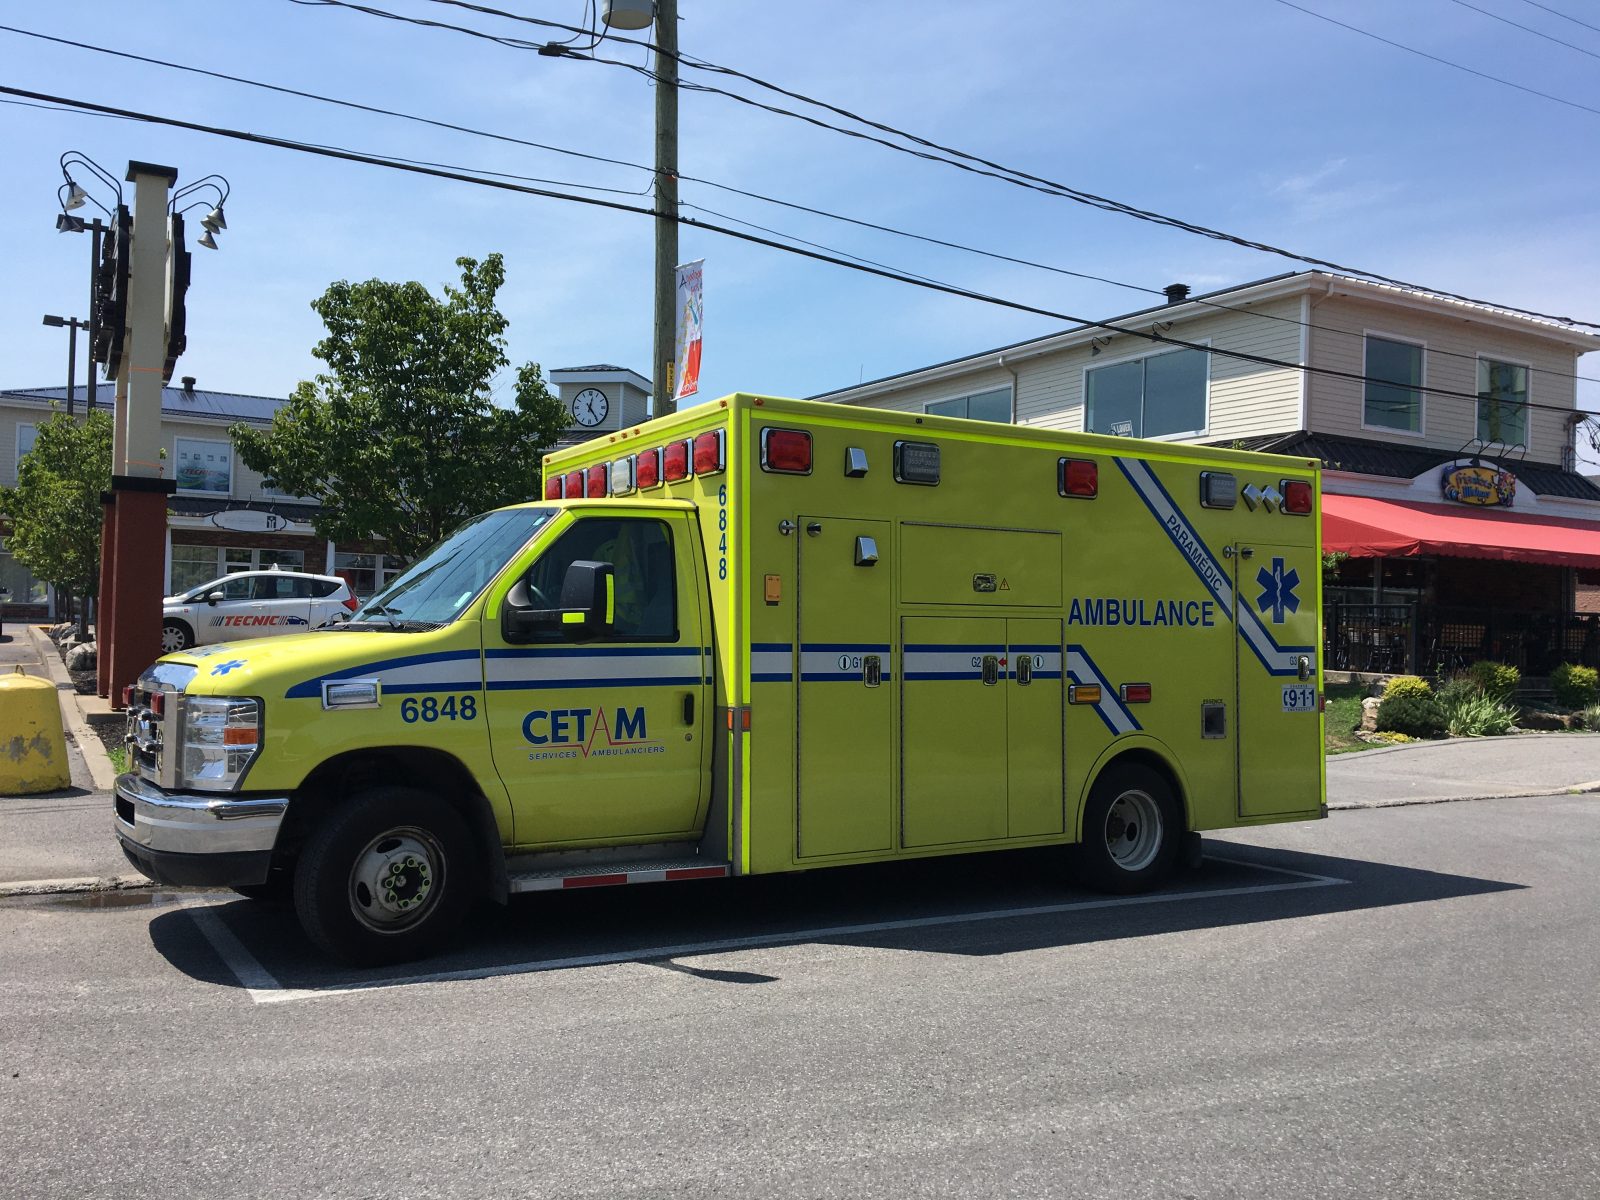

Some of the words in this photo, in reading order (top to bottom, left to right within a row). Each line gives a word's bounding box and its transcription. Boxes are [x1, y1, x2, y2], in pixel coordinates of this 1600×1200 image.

[718, 483, 727, 581] 6848
[1166, 514, 1223, 592] PARAMÉDIC
[224, 615, 280, 627] TECNIC
[1068, 598, 1215, 627] AMBULANCE
[852, 656, 863, 669] G1
[971, 656, 982, 668] G2
[400, 695, 478, 723] 6848
[521, 706, 647, 746] CETAM
[528, 751, 578, 761] SERVICES
[591, 746, 666, 757] AMBULANCIERS
